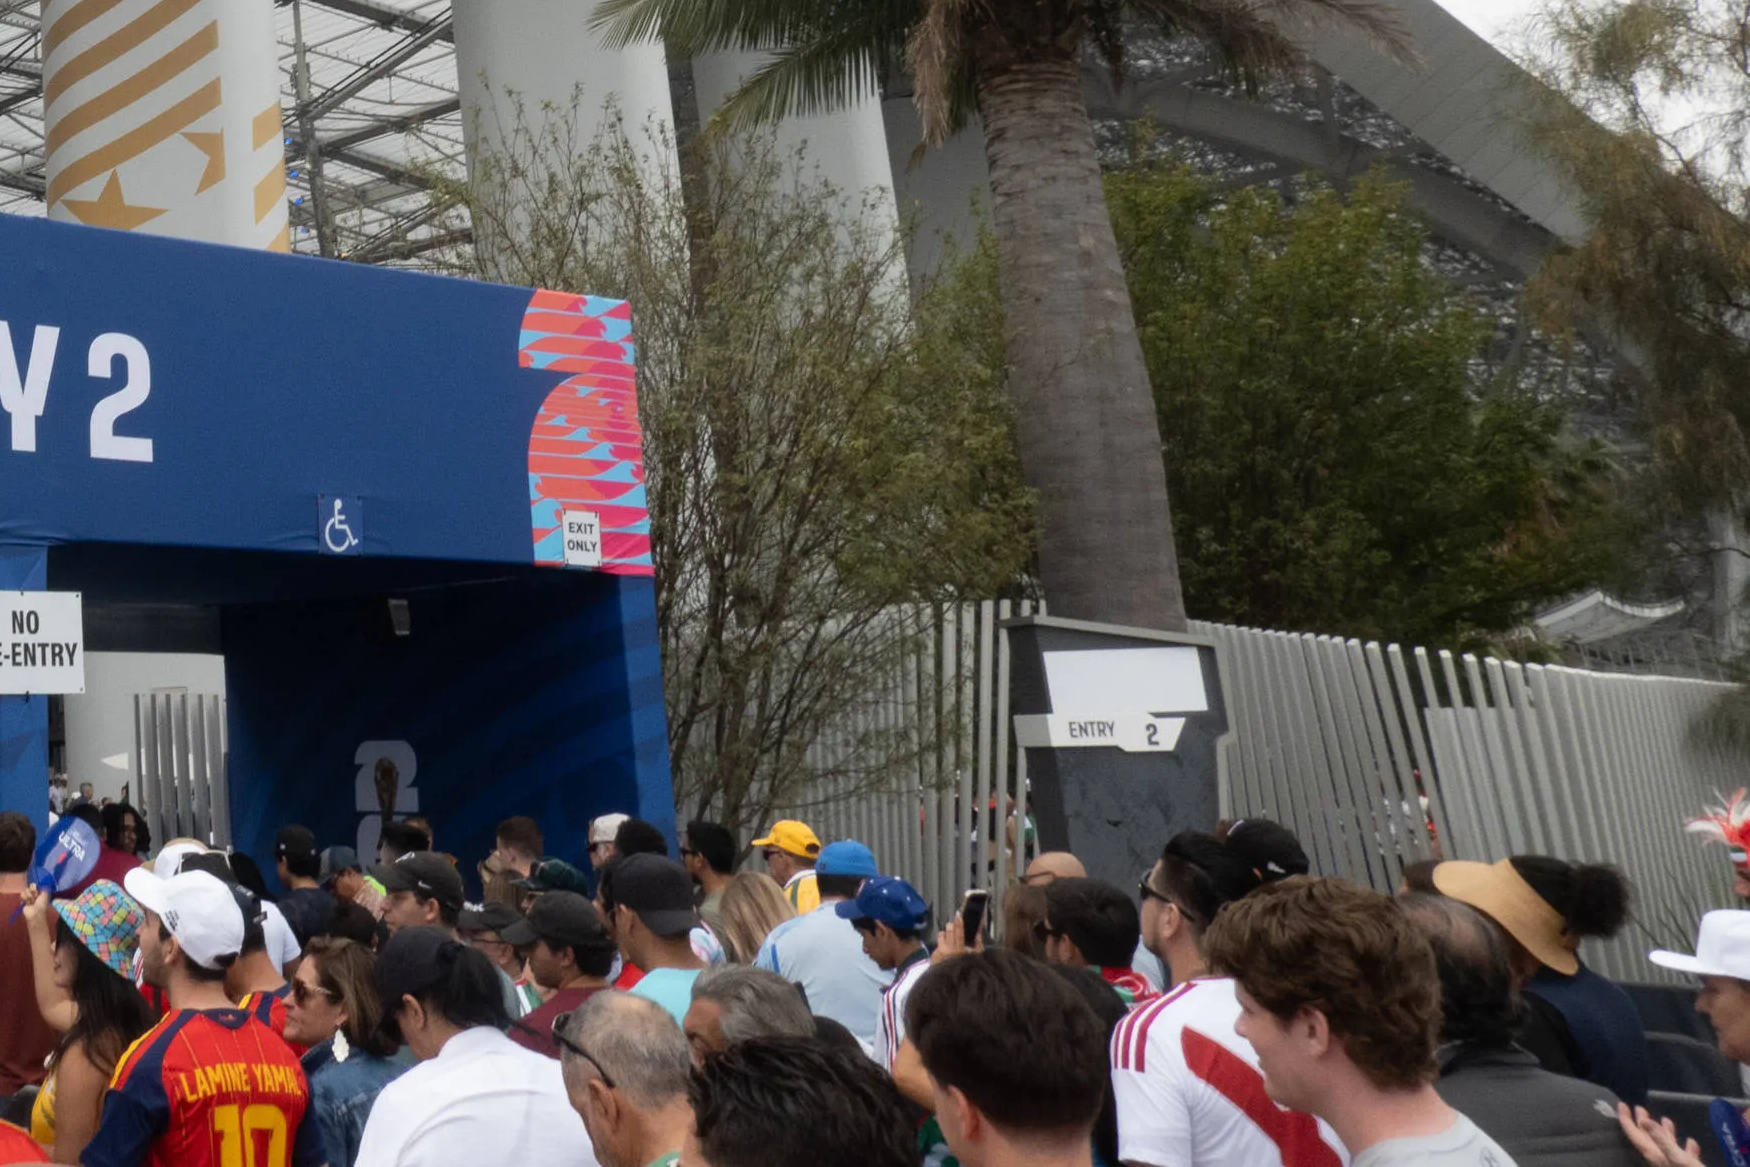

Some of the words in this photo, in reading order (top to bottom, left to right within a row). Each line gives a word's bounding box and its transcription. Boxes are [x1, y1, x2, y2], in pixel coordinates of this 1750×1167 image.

[87, 332, 154, 463] 2
[568, 522, 594, 535] EXIT
[567, 540, 597, 553] ONLY
[11, 610, 40, 635] NO
[1068, 721, 1115, 738] ENTRY
[1145, 723, 1159, 745] 2
[58, 830, 86, 863] ULTRA
[178, 1062, 251, 1103] LAMINE
[214, 1104, 287, 1167] 10
